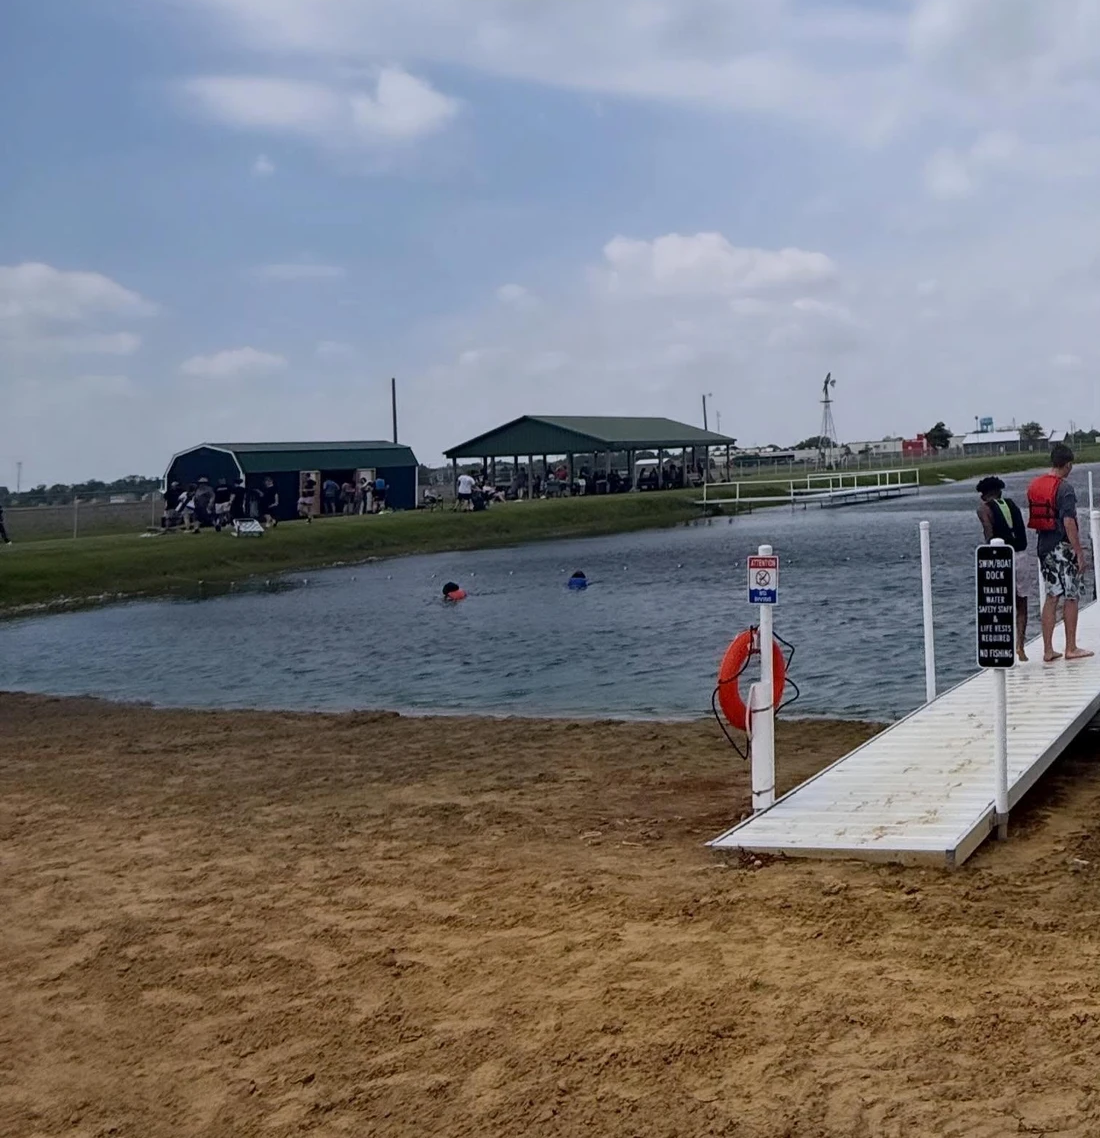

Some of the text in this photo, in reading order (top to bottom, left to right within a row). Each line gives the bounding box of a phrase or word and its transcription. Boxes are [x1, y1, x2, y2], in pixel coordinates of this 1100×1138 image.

[750, 558, 776, 567] ATTENTION
[979, 559, 1012, 568] SWIM/BOAT
[985, 571, 1005, 580] DOCK
[983, 586, 1008, 594] TRAINED
[986, 596, 1005, 604] WATER
[979, 605, 996, 613] SAFETY
[980, 624, 1012, 632] LIFE VESTS
[981, 634, 1011, 642] REQUIRED
[980, 648, 1013, 658] NO FISHING
